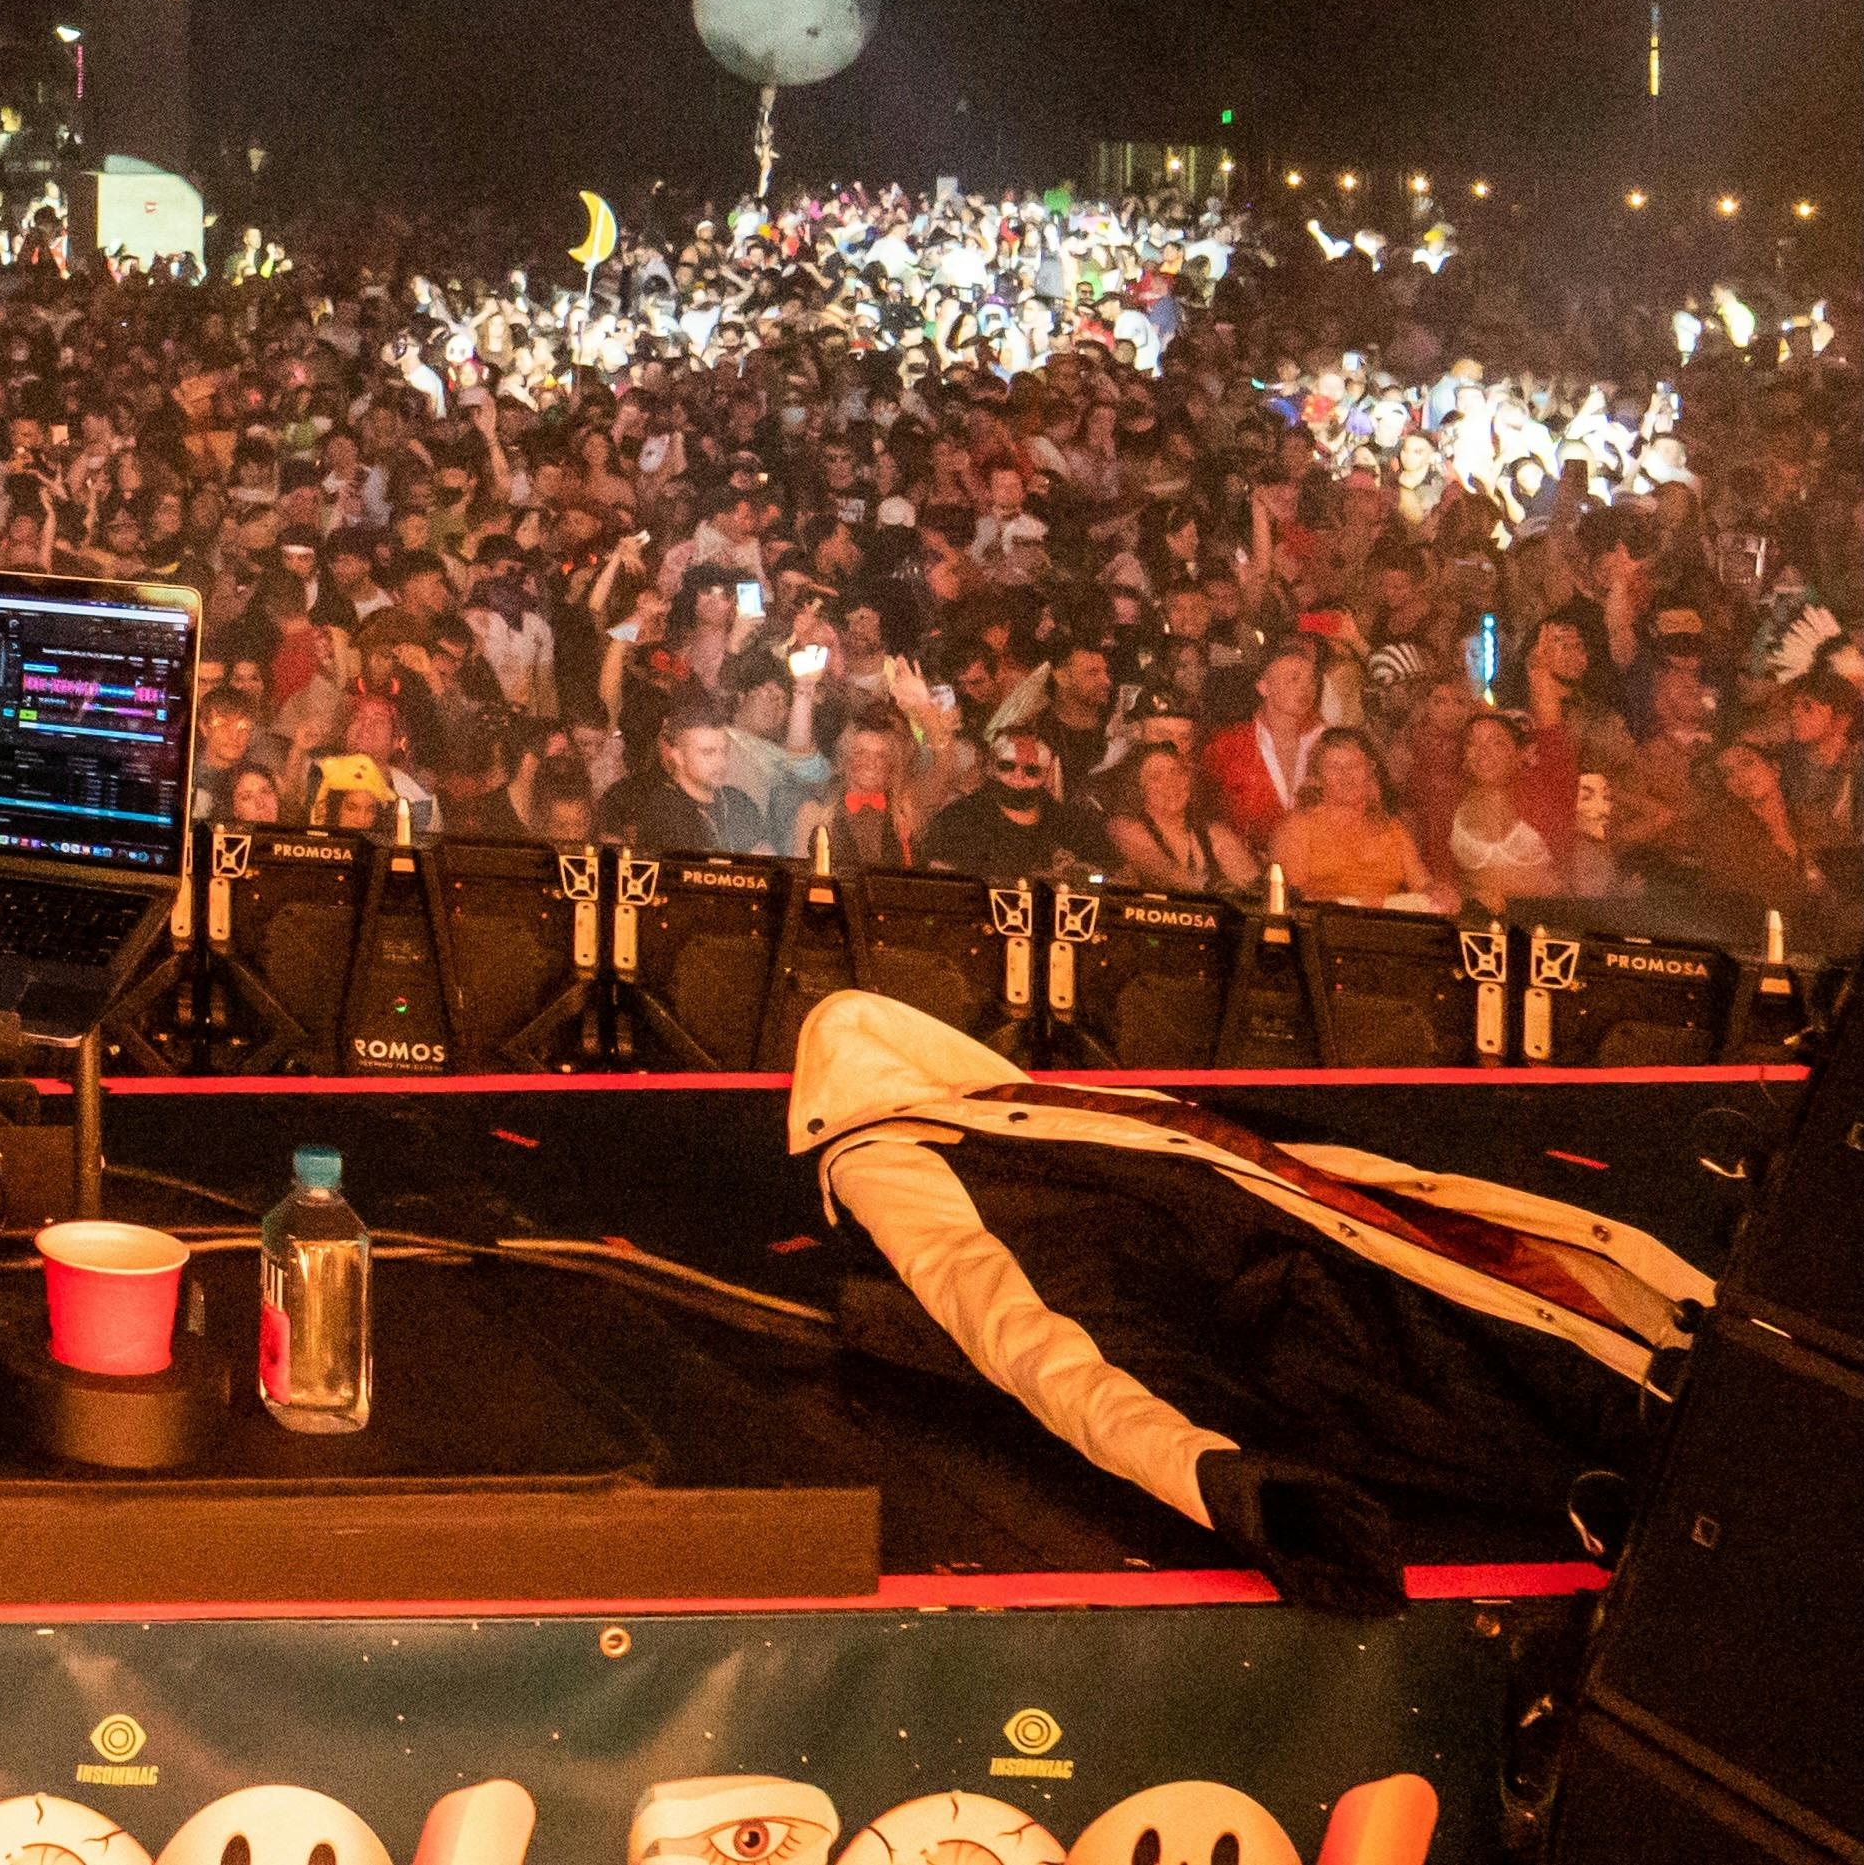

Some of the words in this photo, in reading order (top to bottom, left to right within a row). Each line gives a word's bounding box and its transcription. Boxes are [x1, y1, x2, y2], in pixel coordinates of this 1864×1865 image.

[274, 842, 353, 861] PROMOSA
[683, 870, 768, 890] PROMOSA
[1124, 906, 1217, 929] PROMOSA
[1606, 952, 1708, 977] PROMOSA
[75, 1763, 160, 1786] INSOMNIAC
[989, 1756, 1075, 1780] INSOMNIAC
